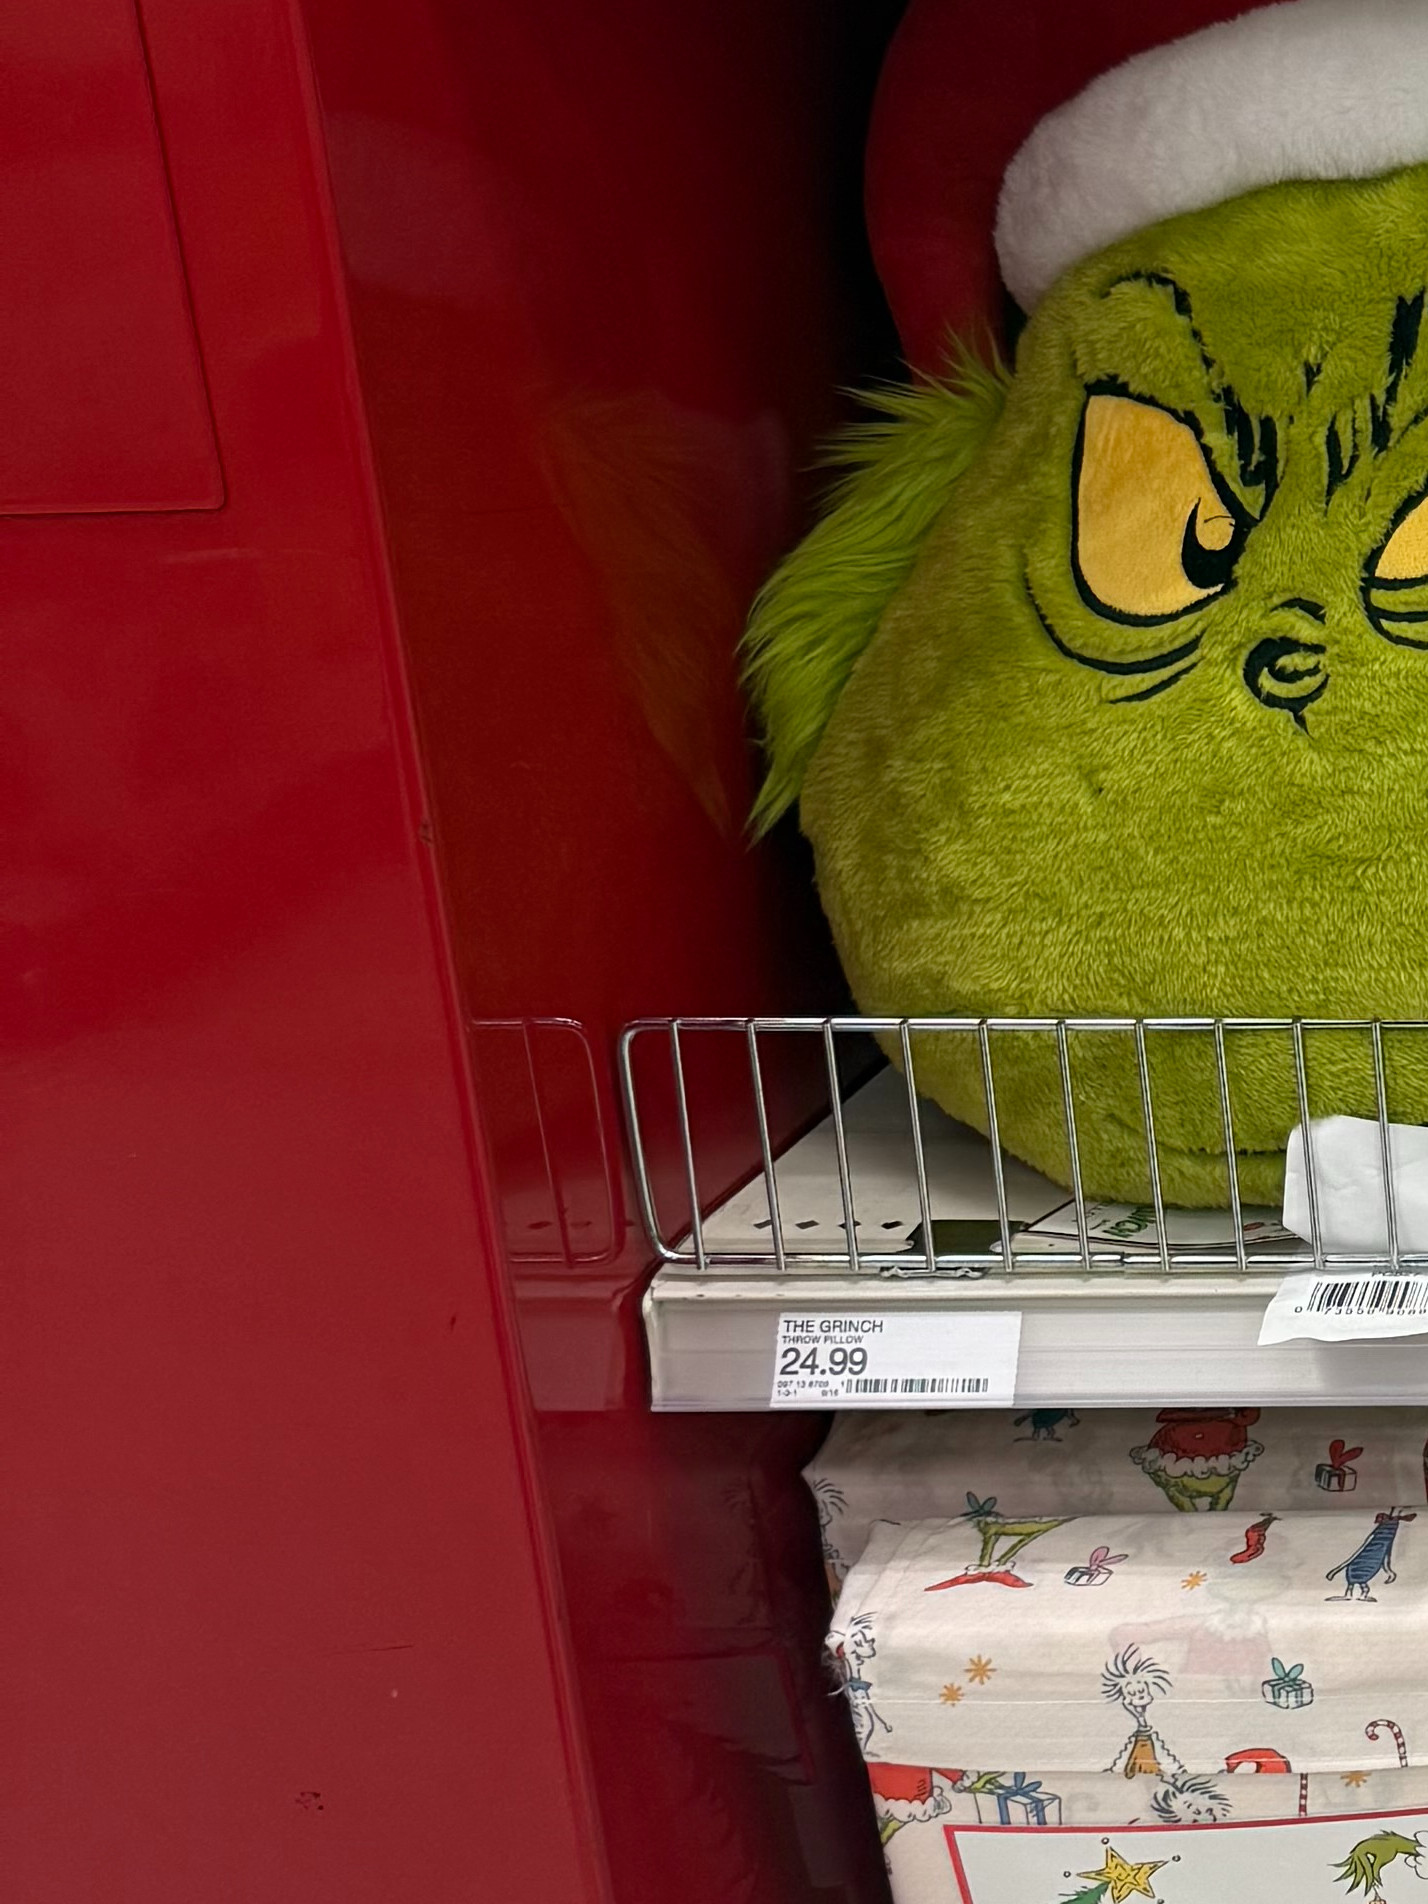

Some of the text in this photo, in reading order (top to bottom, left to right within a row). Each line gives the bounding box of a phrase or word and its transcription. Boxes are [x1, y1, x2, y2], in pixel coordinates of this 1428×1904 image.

[783, 1320, 883, 1333] THE GRINCH
[782, 1335, 863, 1344] THROW PILLOW
[780, 1347, 868, 1376] 24.99
